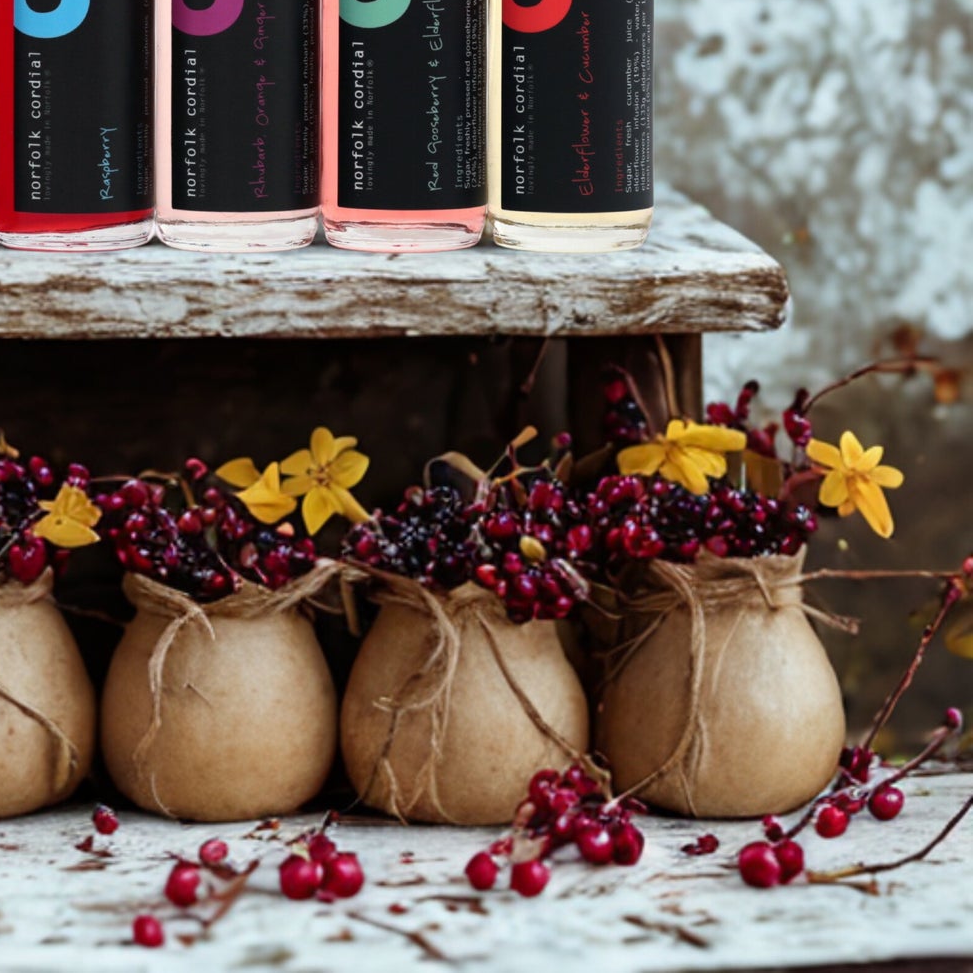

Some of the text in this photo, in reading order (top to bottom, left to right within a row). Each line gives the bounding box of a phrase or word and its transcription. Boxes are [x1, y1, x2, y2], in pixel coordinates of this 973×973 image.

[253, 3, 275, 49] Ginger
[427, 59, 438, 67] &
[255, 75, 275, 125] Orange
[352, 41, 364, 190] norfolk cordial
[367, 110, 373, 119] in
[426, 75, 447, 154] Gooseberry
[464, 79, 472, 118] pressed
[513, 45, 525, 194] norfolk cordial
[527, 115, 534, 123] in
[571, 11, 595, 195] Elderflower & Cucumber
[28, 51, 41, 200] norfolk cordial
[44, 120, 51, 130] in
[185, 49, 196, 197] norfolk cordial
[464, 121, 472, 155] freshly
[97, 127, 119, 200] Raspberry
[366, 151, 374, 190] lovingly
[455, 115, 464, 188] Ingredients
[464, 158, 472, 189] Sugar,
[615, 119, 624, 192] Ingredients
[44, 161, 52, 200] lovingly
[426, 162, 442, 191] Red
